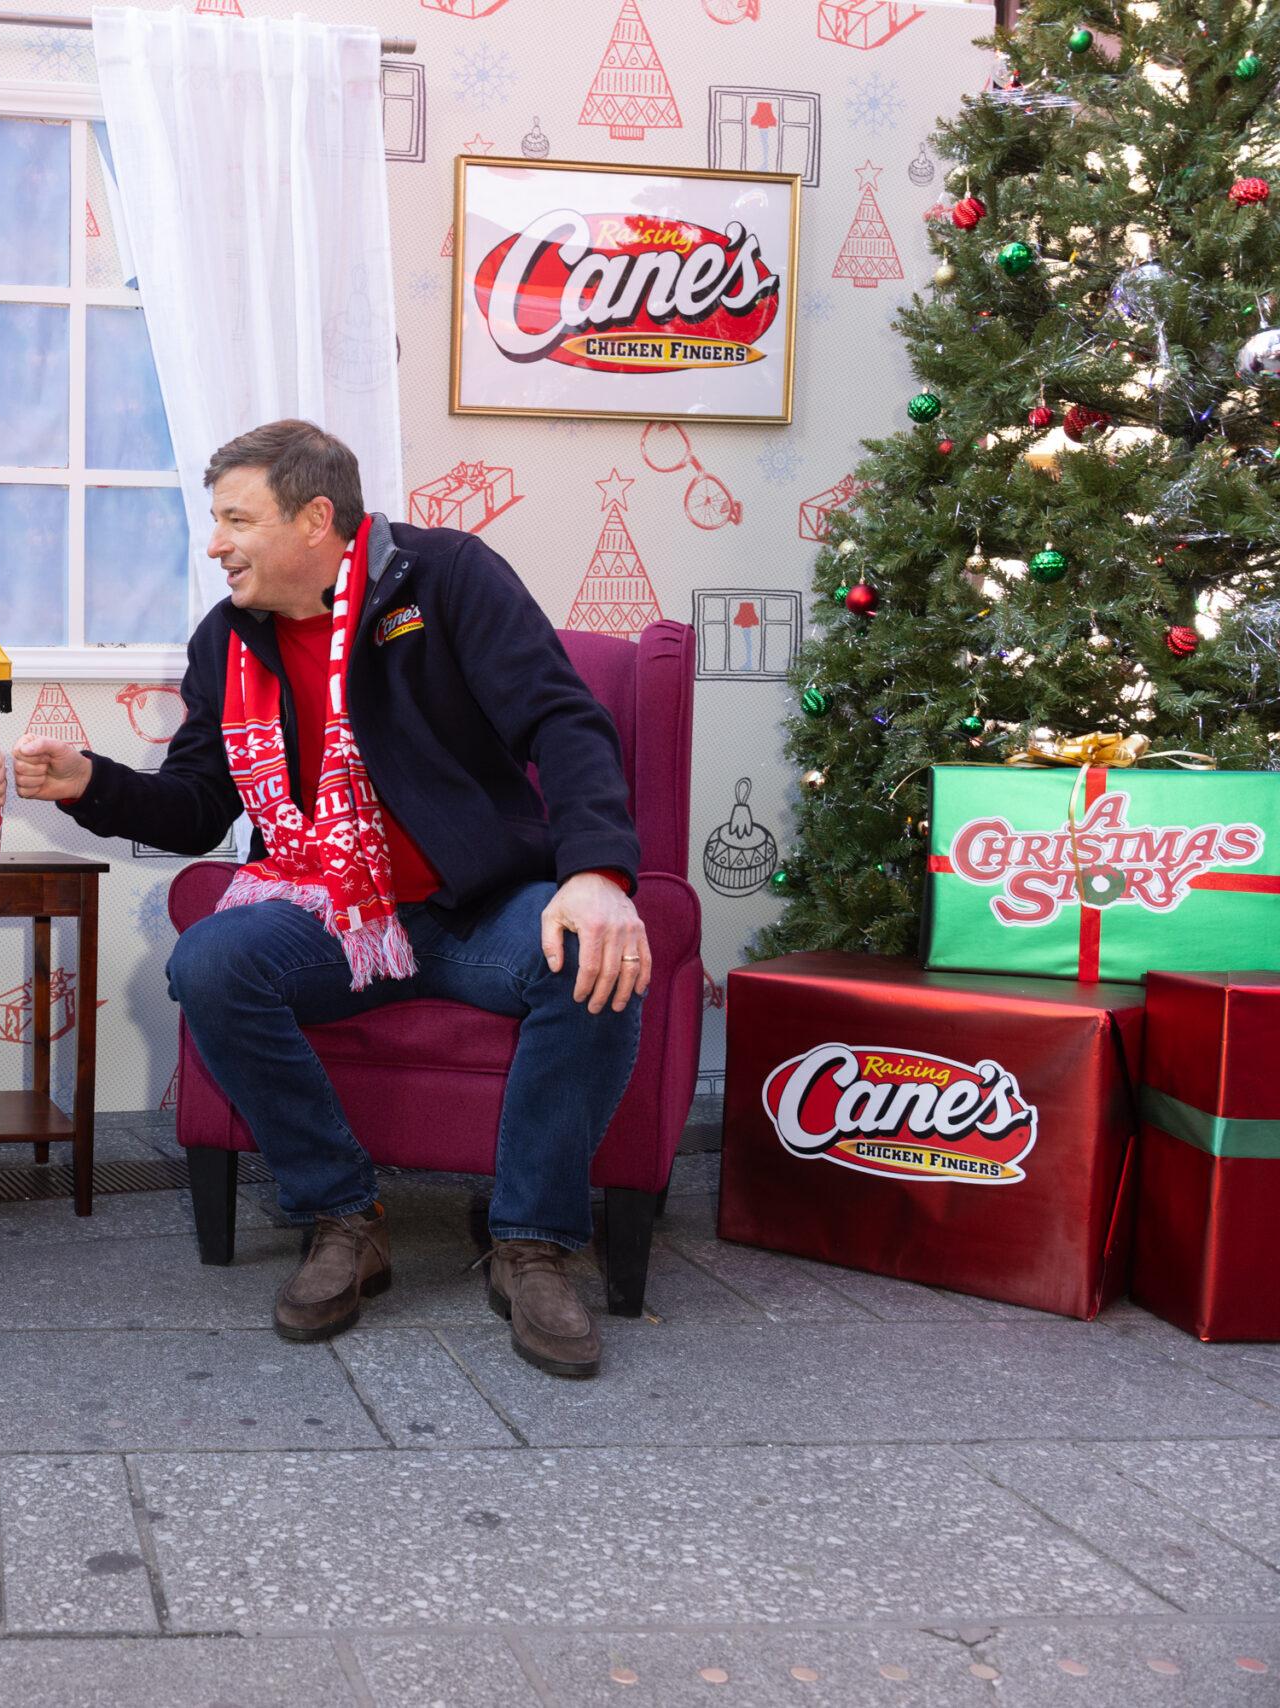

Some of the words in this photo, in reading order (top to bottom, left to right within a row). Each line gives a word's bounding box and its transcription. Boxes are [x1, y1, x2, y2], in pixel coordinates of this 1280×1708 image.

[595, 220, 697, 254] Raising
[487, 208, 780, 361] Cane's
[585, 338, 664, 359] CHICKEN
[669, 341, 746, 362] FINGERS
[376, 604, 421, 647] Cane's
[1070, 795, 1125, 832] A
[955, 820, 1258, 880] CHRISTMAS
[995, 862, 1202, 921] STORY
[863, 1056, 951, 1086] Raising
[777, 1045, 1034, 1155] Cane's
[855, 1142, 924, 1164] CHICKEN
[929, 1153, 1000, 1177] FINGERS
